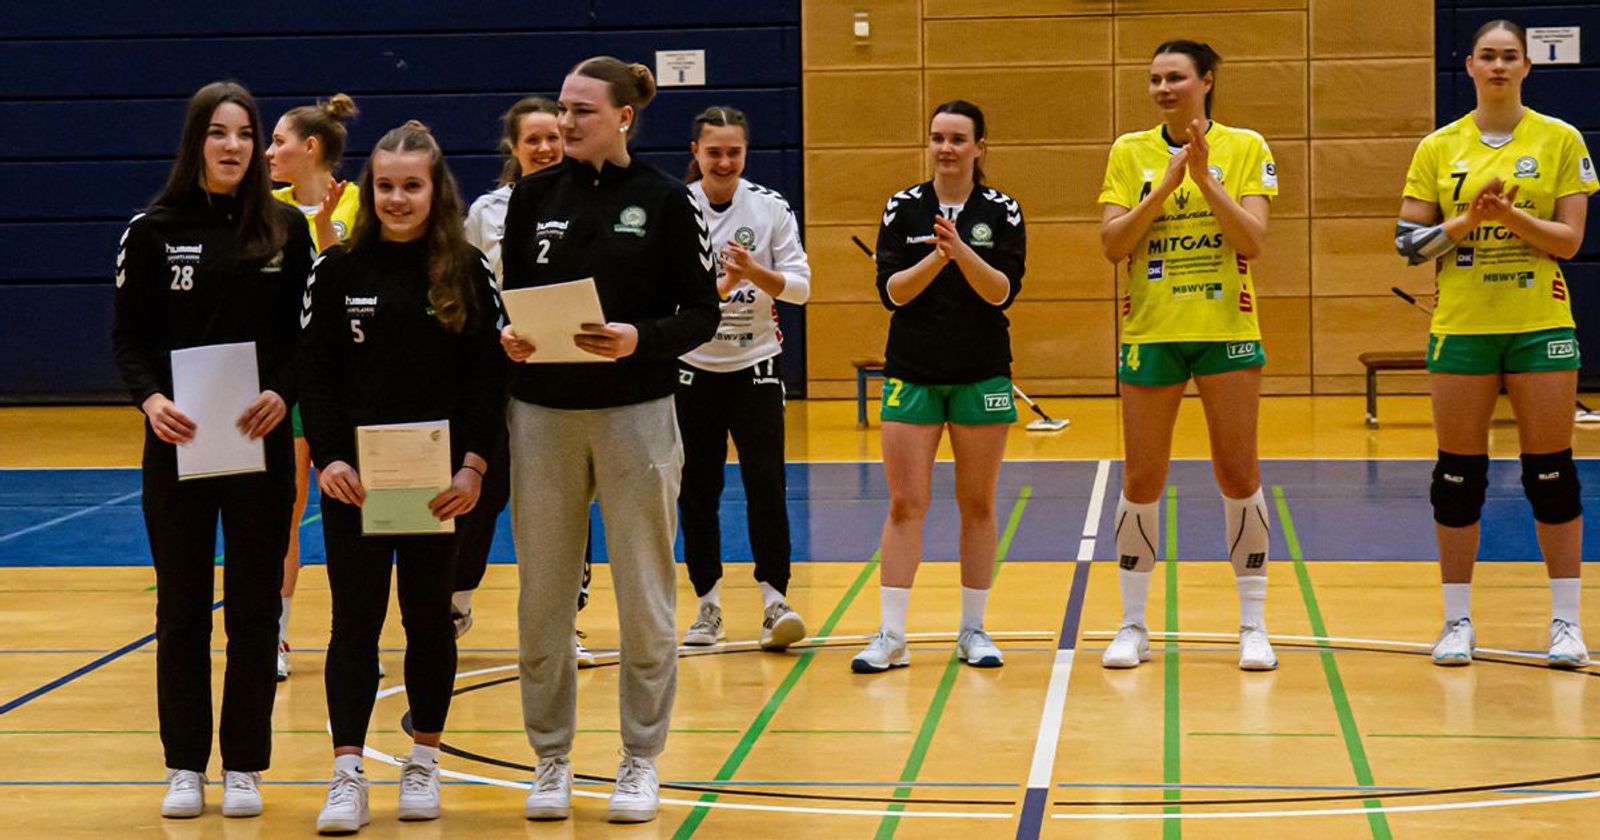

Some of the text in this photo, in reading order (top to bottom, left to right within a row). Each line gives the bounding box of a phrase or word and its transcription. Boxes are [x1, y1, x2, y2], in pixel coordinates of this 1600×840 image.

[1451, 172, 1468, 201] 7
[165, 243, 203, 254] hummel
[536, 239, 550, 264] 2
[1148, 233, 1223, 254] MITGAS
[170, 265, 194, 290] 28
[1172, 284, 1204, 295] MBWV
[345, 295, 378, 306] hummel
[350, 319, 365, 343] 5
[1127, 343, 1140, 370] 4
[887, 378, 903, 406] 2
